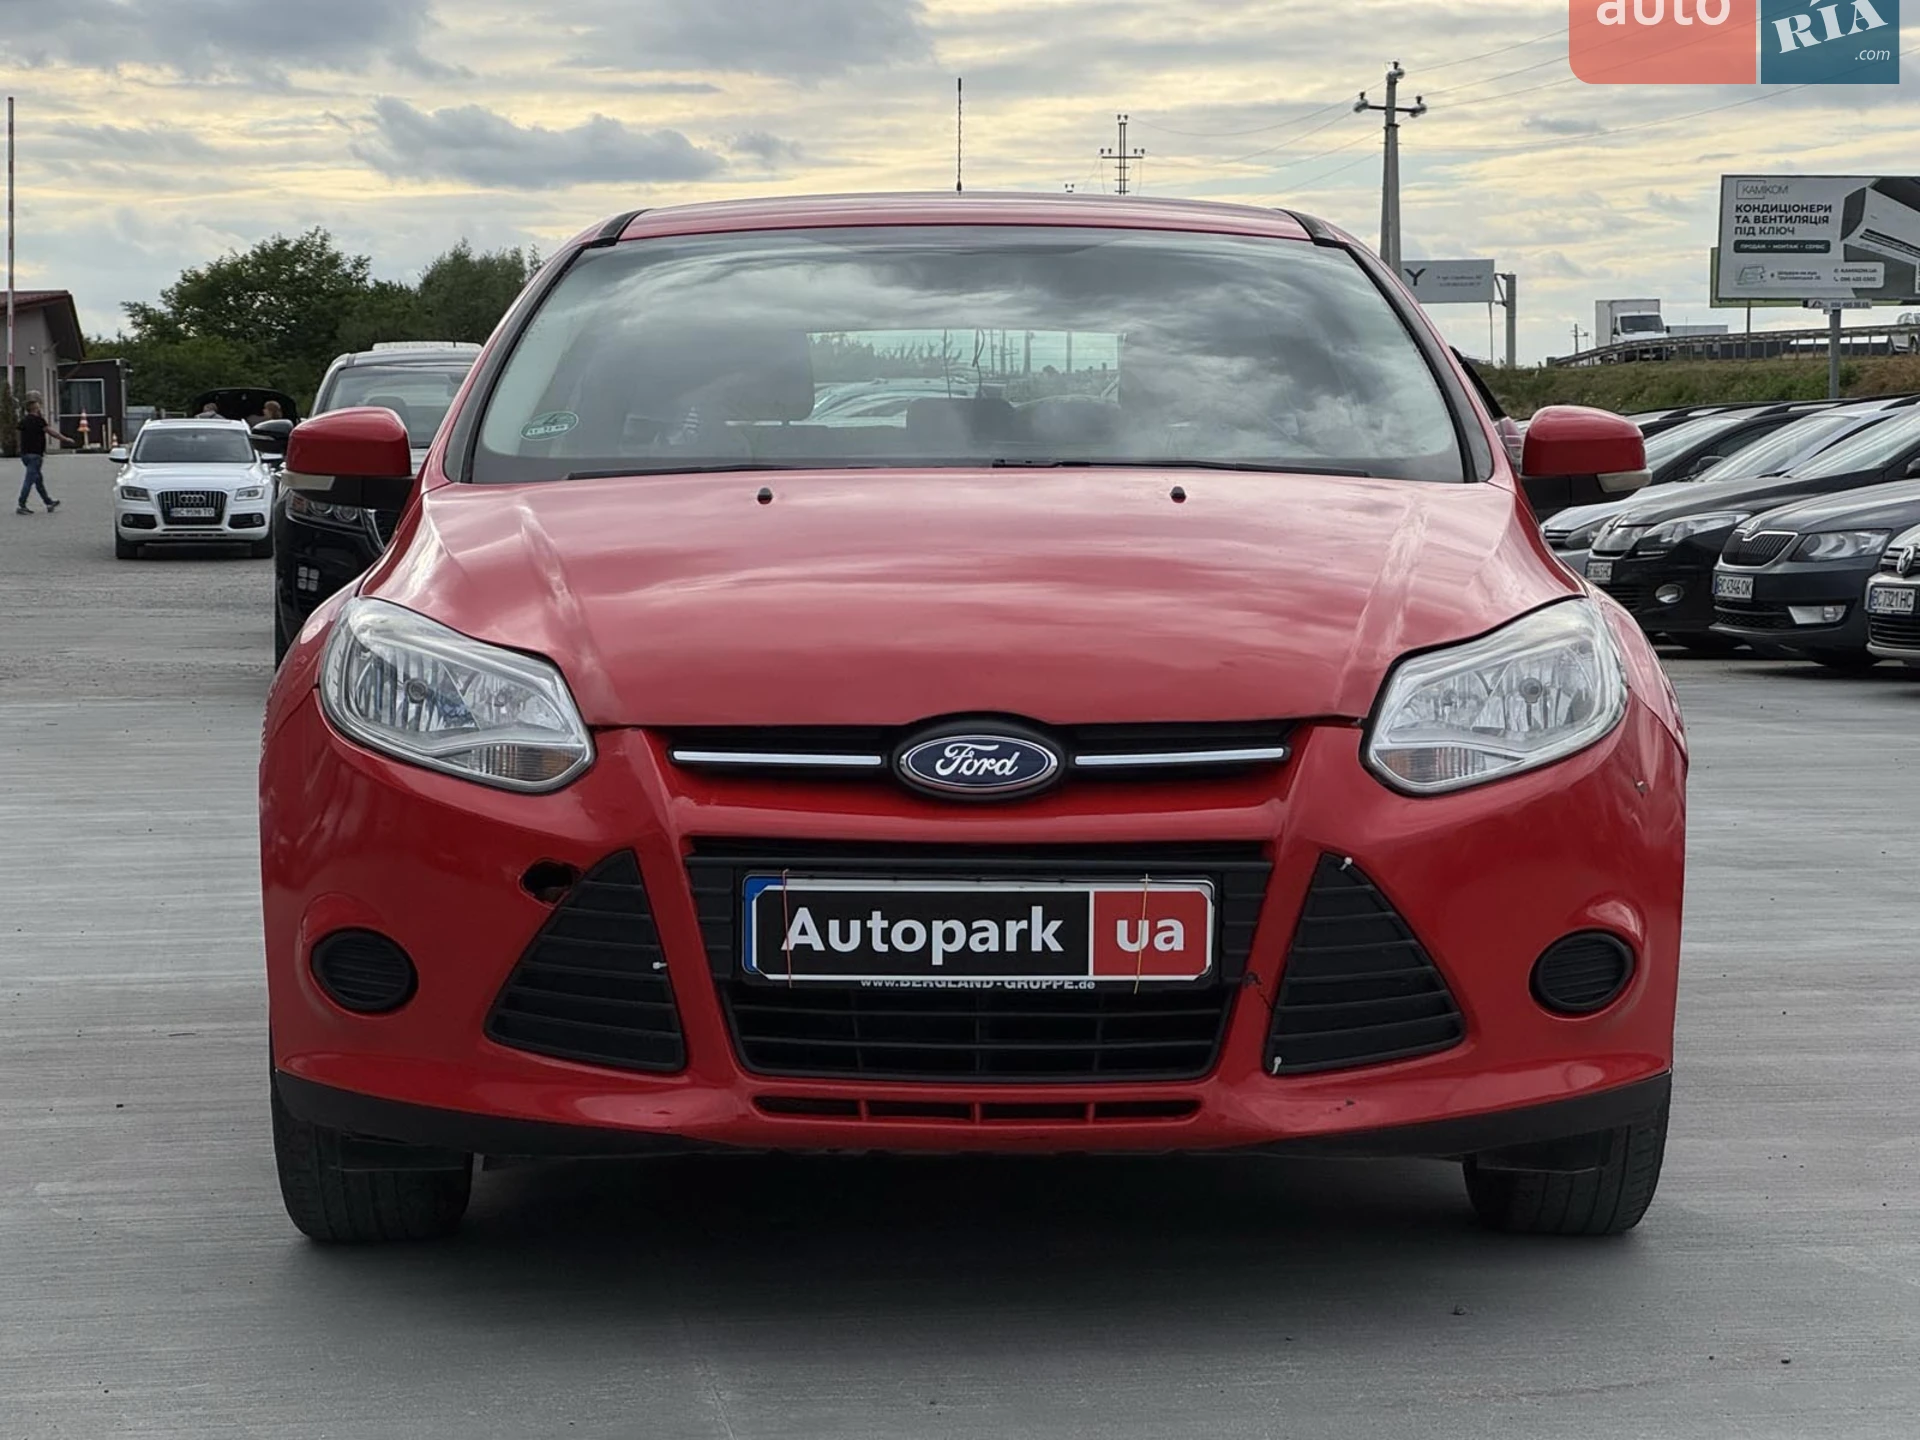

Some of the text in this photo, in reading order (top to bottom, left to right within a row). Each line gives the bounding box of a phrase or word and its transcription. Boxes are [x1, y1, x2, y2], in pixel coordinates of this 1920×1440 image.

[1735, 203, 1833, 214] КОНДИЦІОНЕРИ
[1734, 215, 1830, 225] ТА ВЕНТИЛЯЦІЯ
[1734, 226, 1796, 236] ПІД КЛЮЧ
[935, 742, 1021, 776] Ford
[781, 906, 1185, 966] Autopark ua
